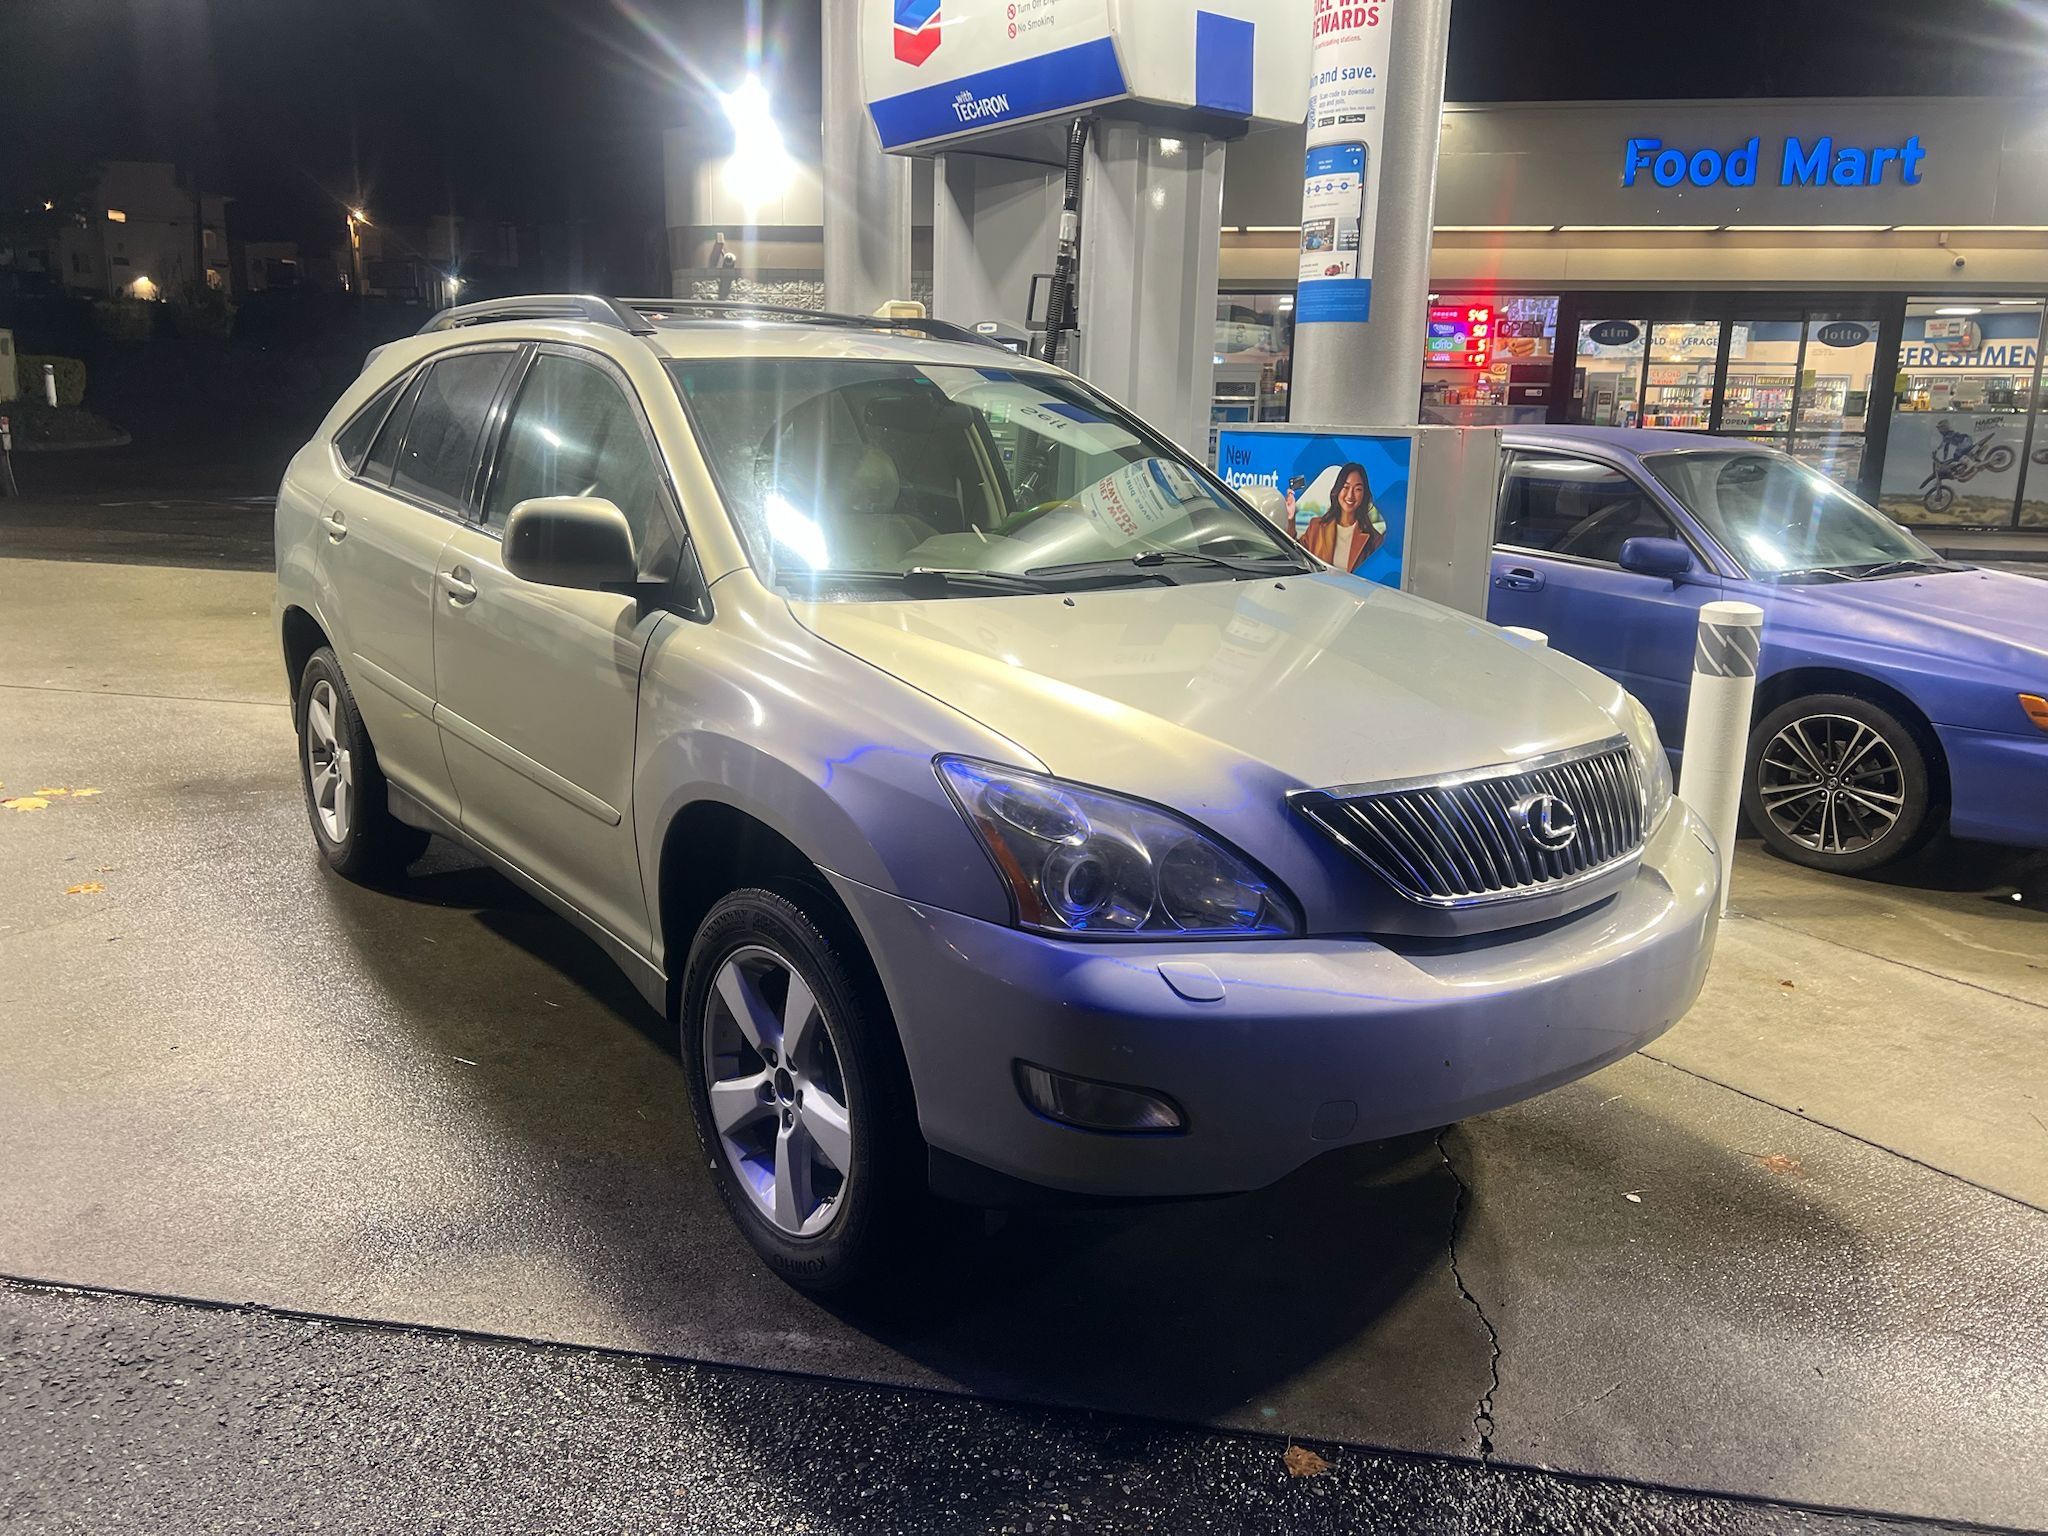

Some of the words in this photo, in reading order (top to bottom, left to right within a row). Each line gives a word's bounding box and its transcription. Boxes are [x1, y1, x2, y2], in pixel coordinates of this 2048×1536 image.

[1017, 3, 1031, 14] Turn
[1313, 0, 1332, 16] UEL
[1018, 23, 1026, 33] No
[1027, 15, 1055, 30] Smoking
[1320, 67, 1338, 84] and
[1341, 66, 1376, 80] save.
[955, 90, 974, 104] with
[952, 94, 1010, 122] TECHRON
[1621, 136, 1760, 188] Food
[1780, 136, 1926, 188] Mart
[1600, 327, 1629, 338] atm
[1824, 326, 1862, 340] lotto
[1725, 418, 1747, 426] OPEN
[1226, 444, 1252, 465] New
[1225, 466, 1279, 488] Account
